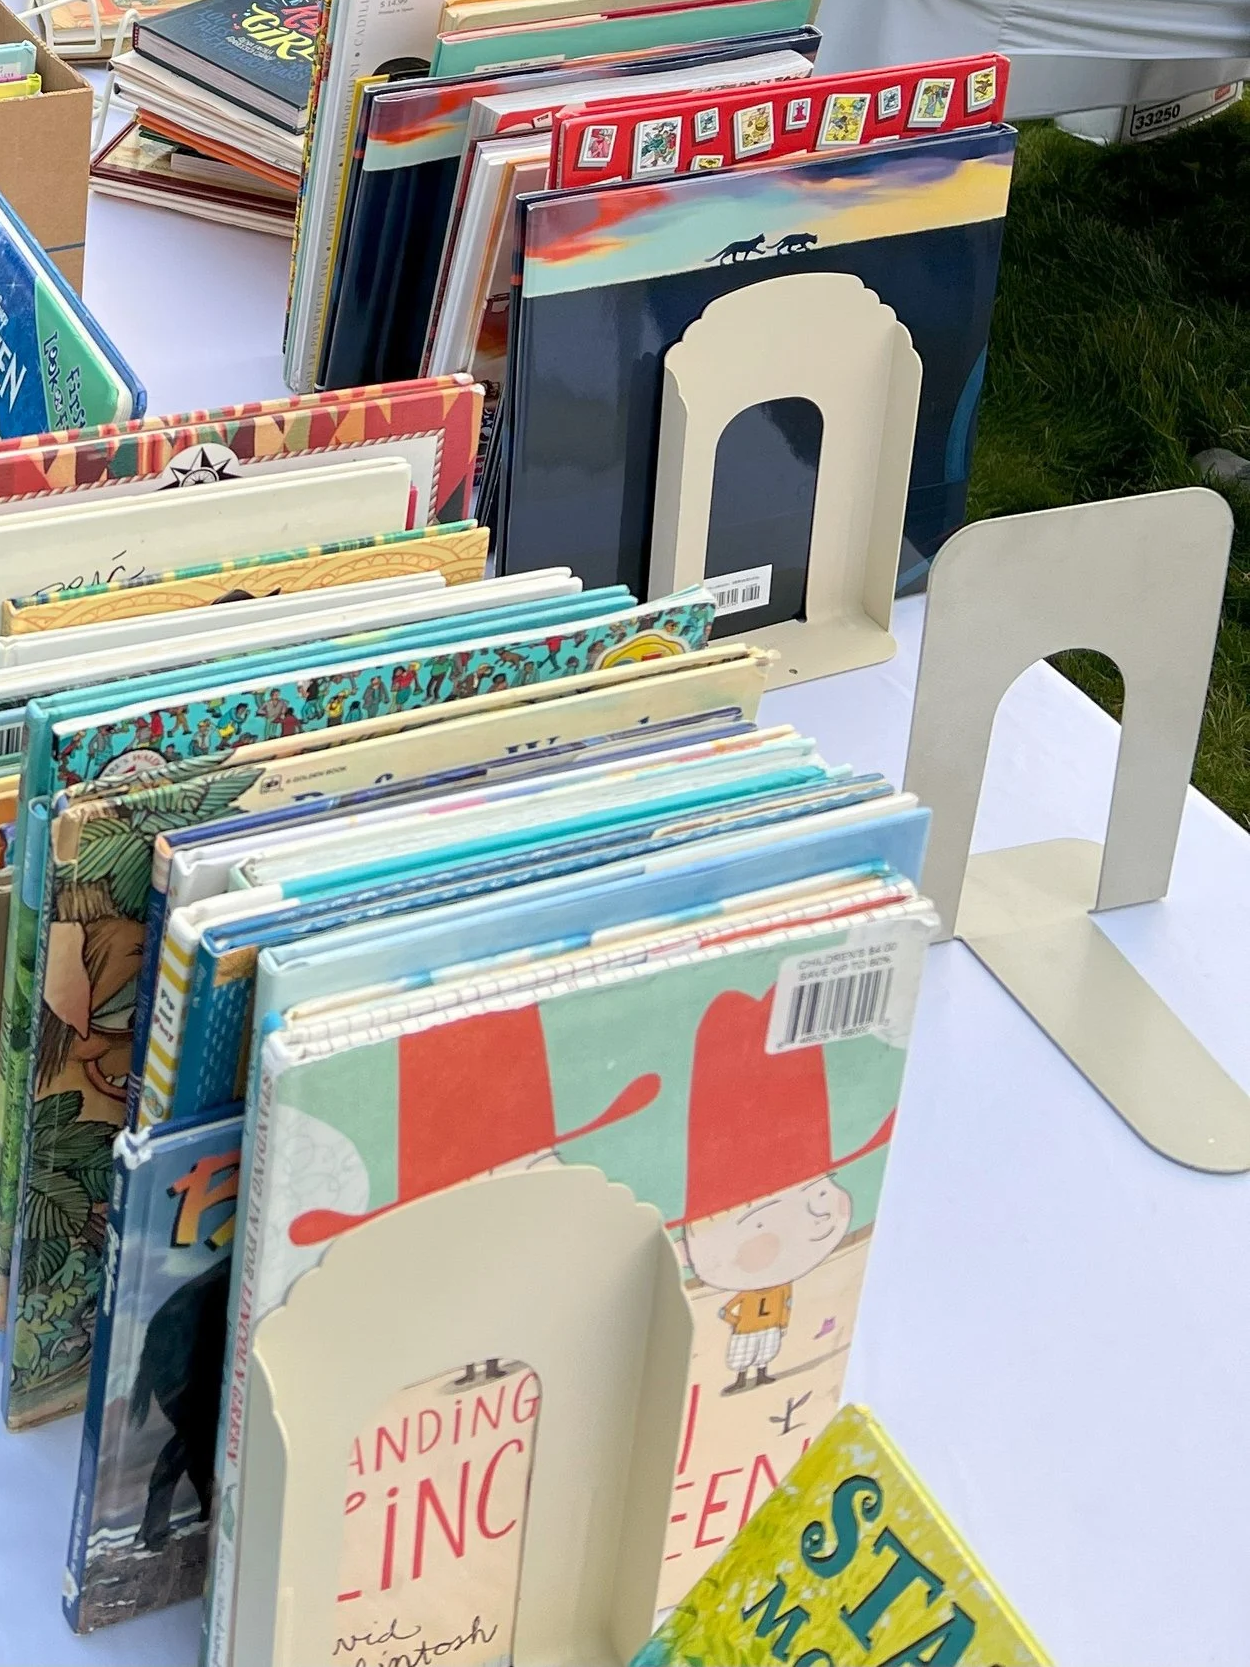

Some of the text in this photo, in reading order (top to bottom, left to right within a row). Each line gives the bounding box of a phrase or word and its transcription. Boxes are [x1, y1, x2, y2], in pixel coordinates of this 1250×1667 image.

[1135, 104, 1180, 130] 33250
[799, 967, 829, 981] SAVE
[226, 1071, 273, 1467] STANDING IN FOR LINCOLN GREEN
[757, 1296, 772, 1317] L
[348, 1371, 541, 1476] ANDING
[332, 1617, 423, 1656] vid
